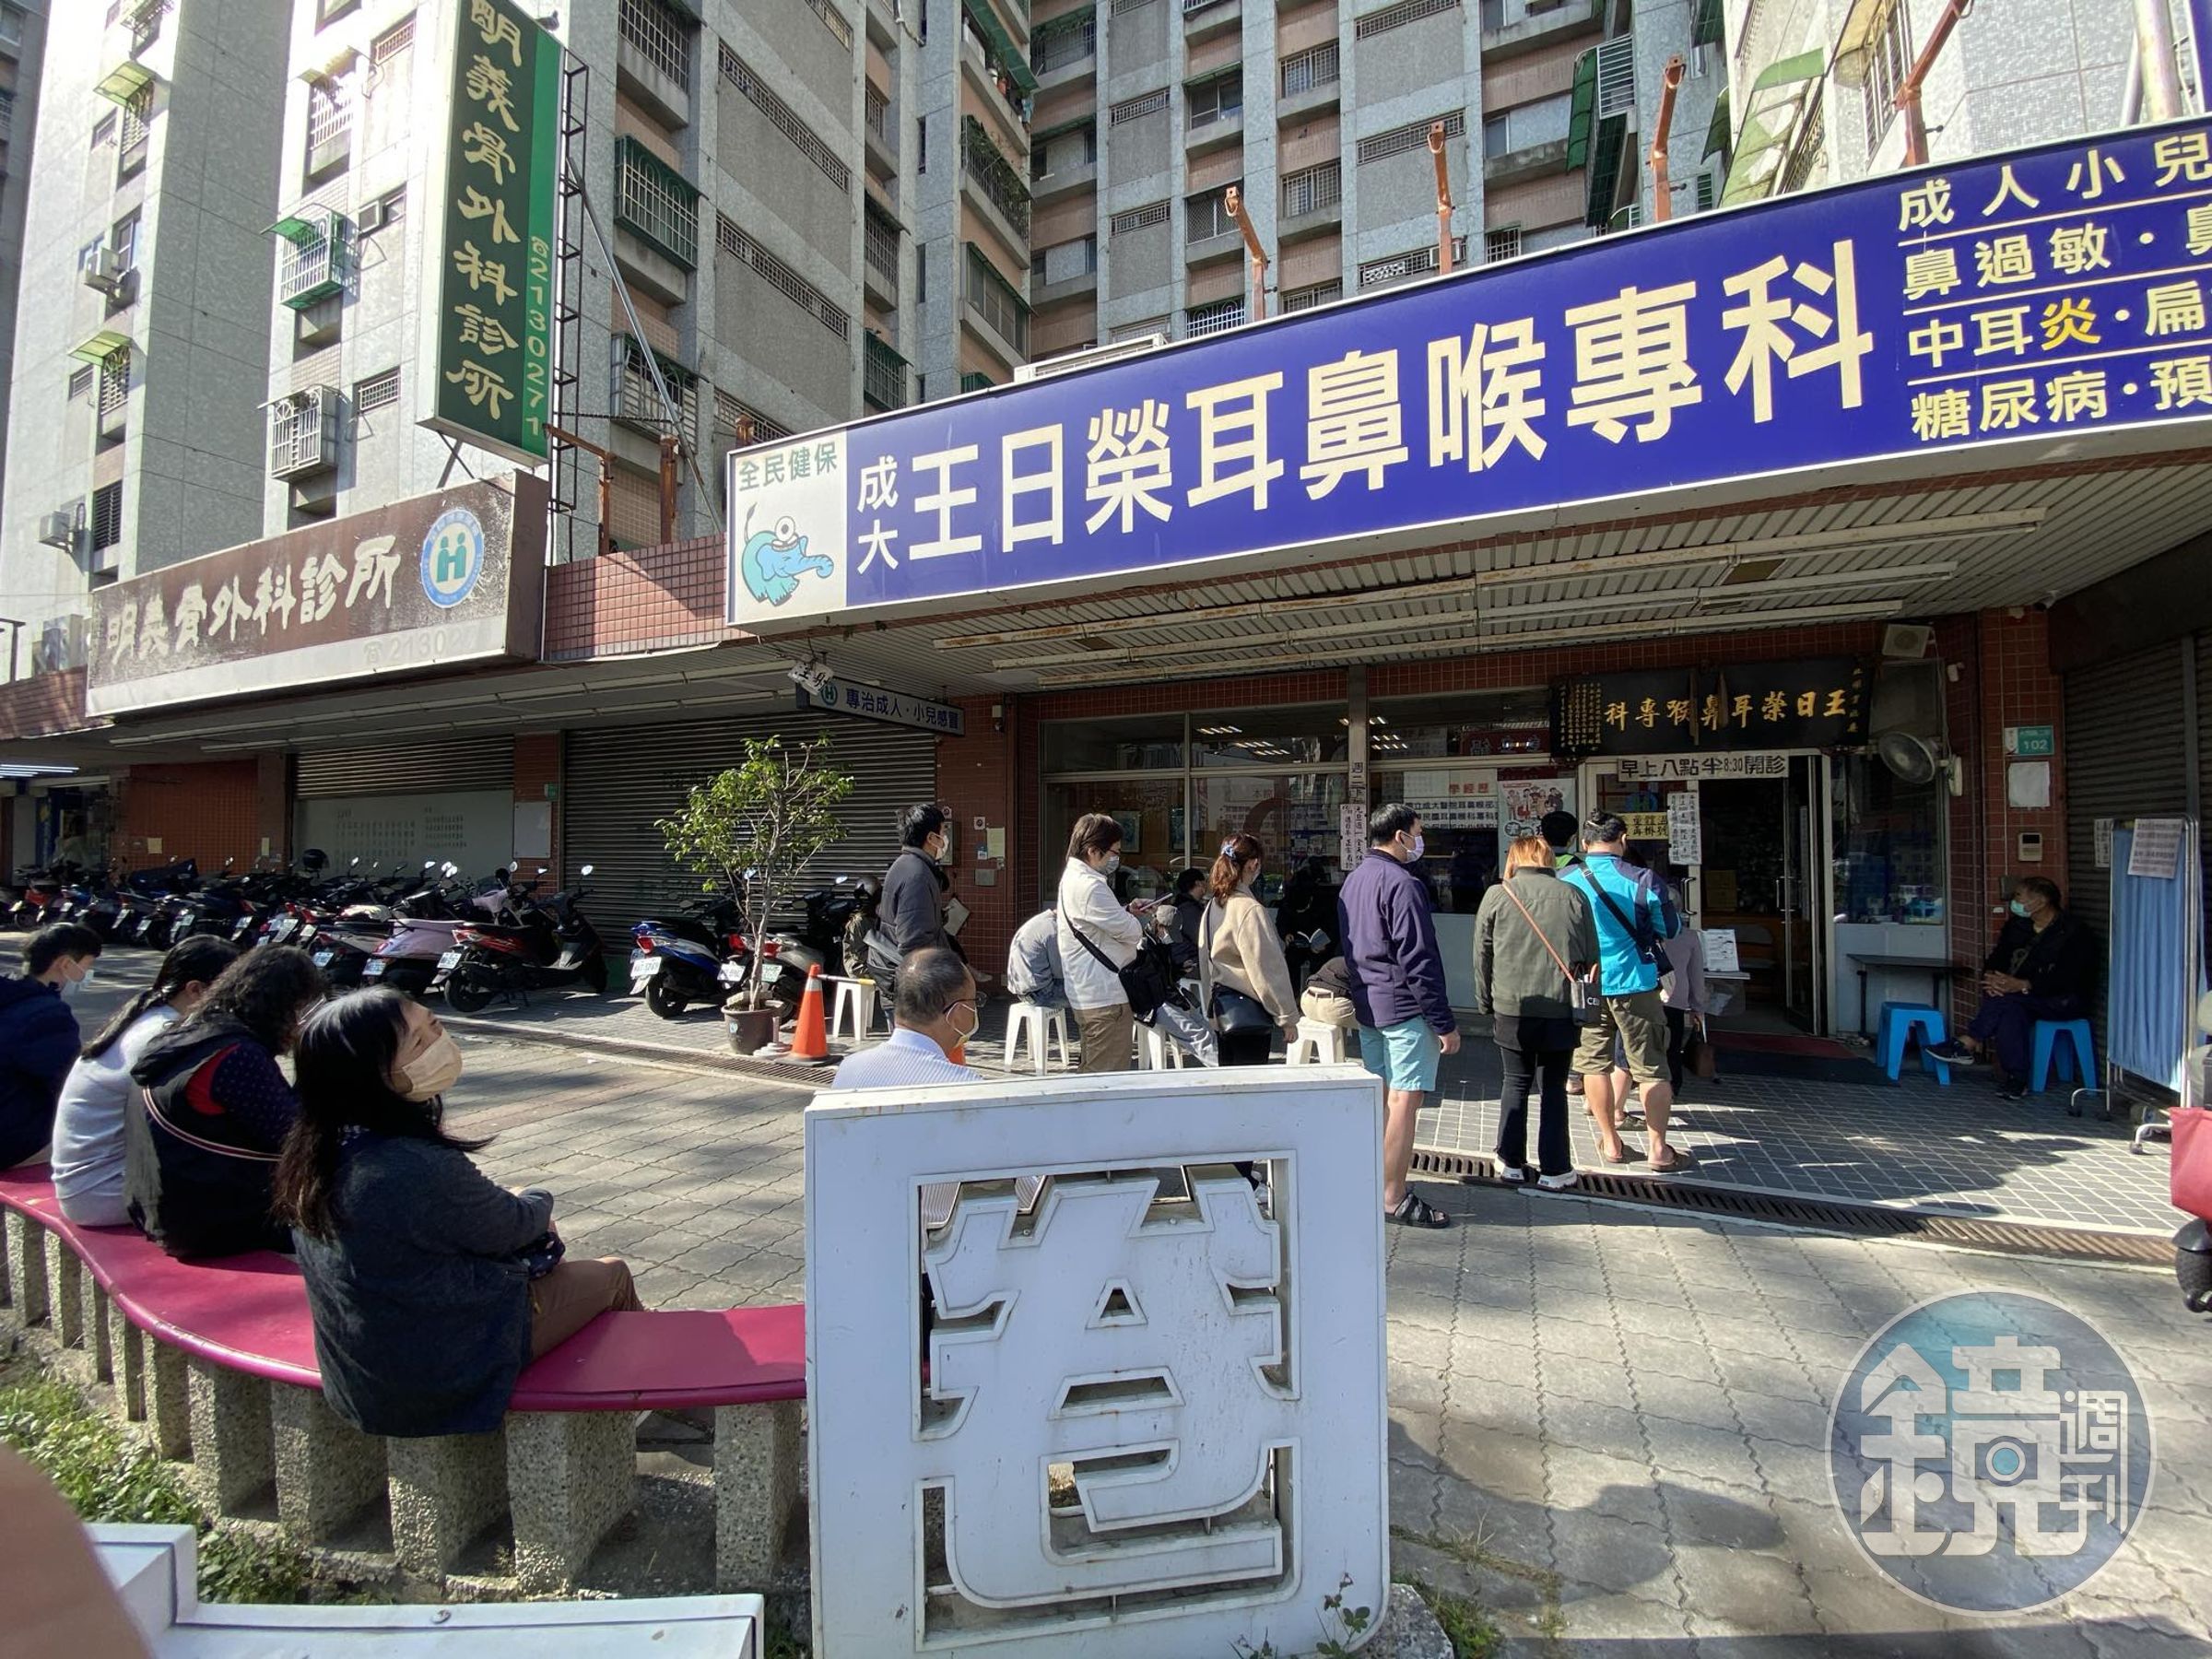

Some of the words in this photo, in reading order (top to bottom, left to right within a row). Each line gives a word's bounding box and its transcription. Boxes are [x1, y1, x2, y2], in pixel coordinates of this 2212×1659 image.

[1899, 132, 2212, 231] 成人小兒
[526, 256, 549, 437] 2130271
[910, 239, 1875, 560] 王日榮耳鼻喉專科
[738, 440, 840, 493] 全民健保
[857, 454, 900, 575] 成大
[2023, 739, 2050, 750] 102
